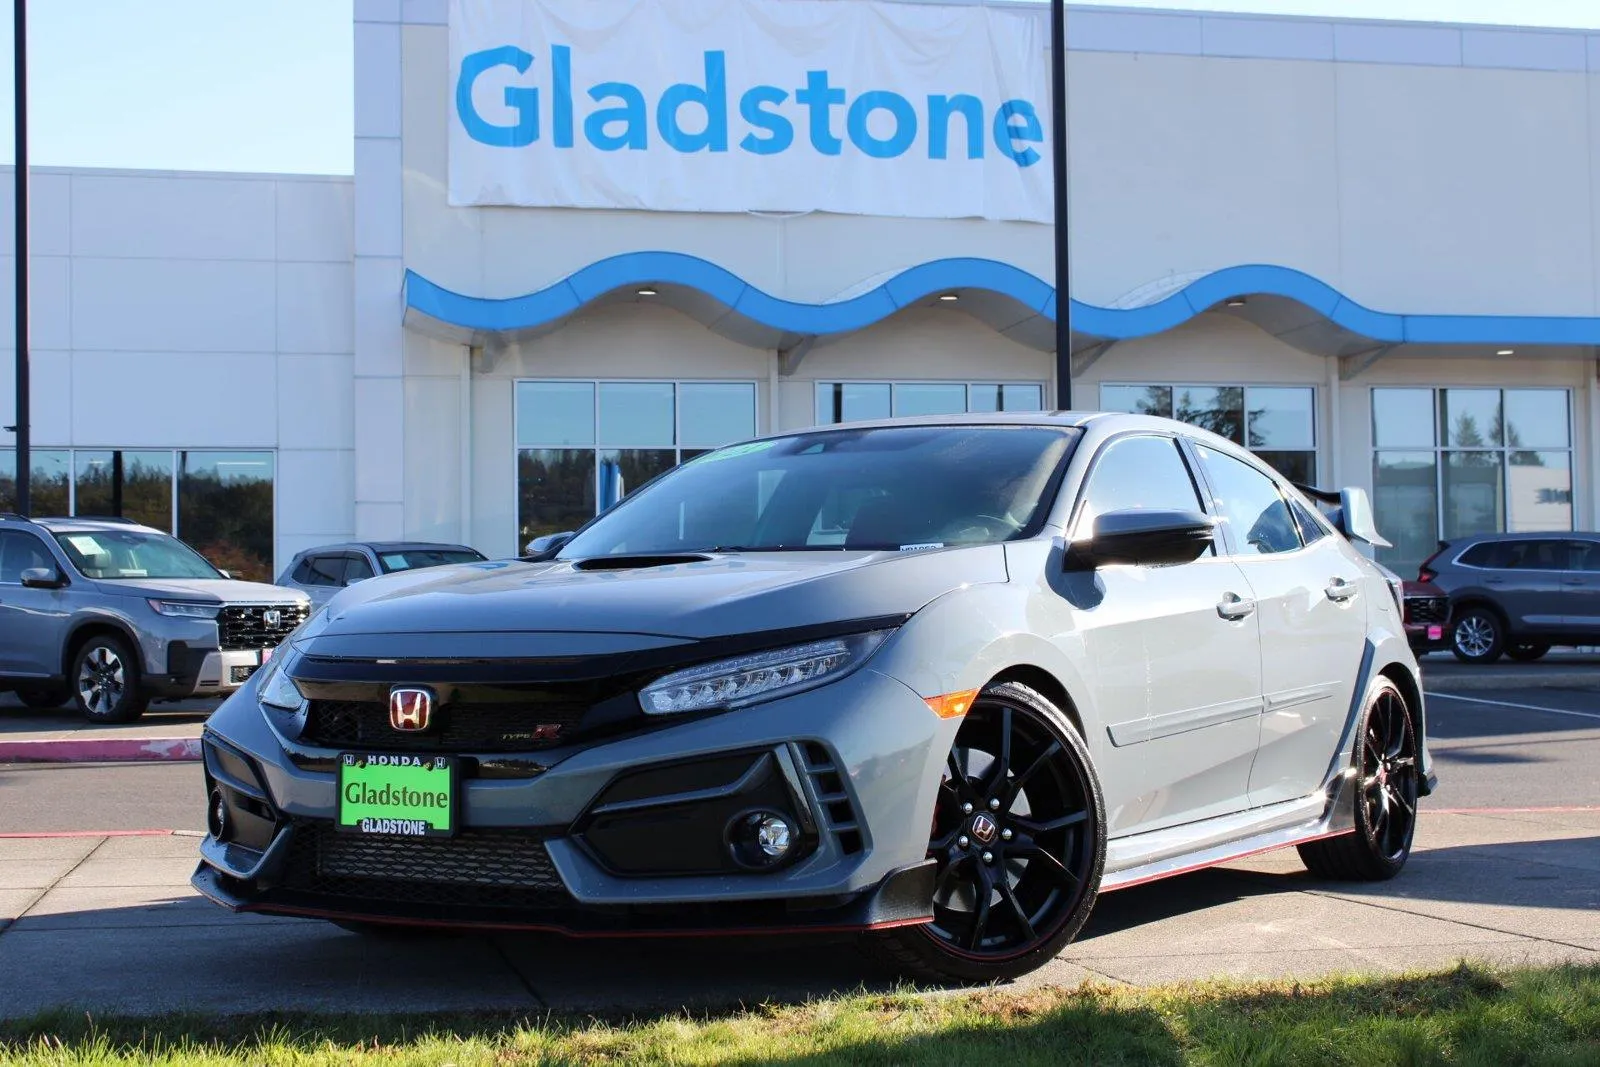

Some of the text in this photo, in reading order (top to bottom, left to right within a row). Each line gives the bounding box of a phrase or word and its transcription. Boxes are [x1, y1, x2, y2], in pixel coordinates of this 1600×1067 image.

[456, 44, 1044, 168] Gladstone
[367, 755, 421, 766] HONDA
[344, 781, 448, 808] Gladstone
[361, 818, 425, 835] GLADSTONE
